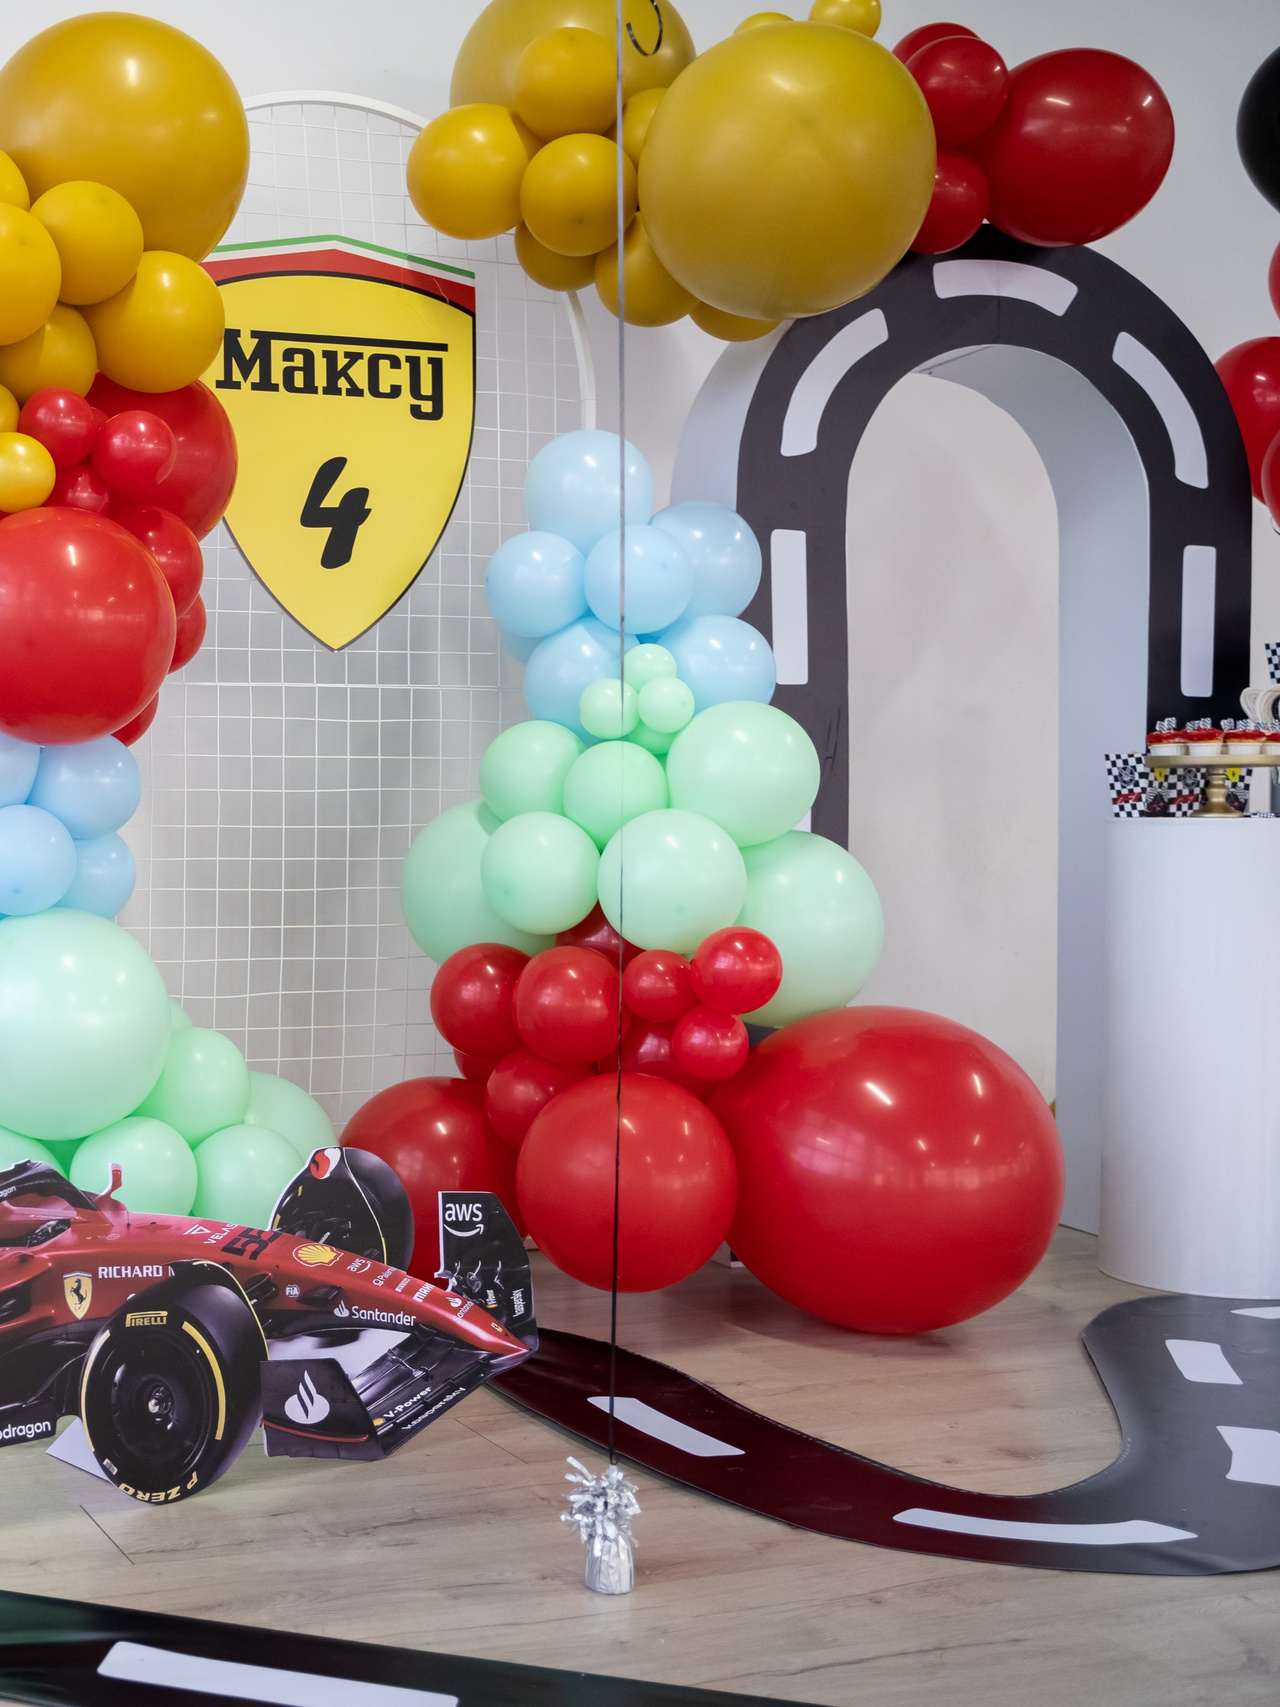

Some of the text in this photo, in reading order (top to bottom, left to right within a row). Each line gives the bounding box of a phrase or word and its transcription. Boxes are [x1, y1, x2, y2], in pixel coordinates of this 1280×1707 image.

[216, 328, 448, 421] Максу
[300, 456, 372, 570] 4
[445, 1203, 483, 1222] aws
[98, 1265, 163, 1279] RICHARD
[125, 1311, 168, 1327] PIRELLI
[351, 1306, 416, 1327] Santander
[383, 1386, 432, 1418] V-Power
[118, 1482, 181, 1502] ZERO
